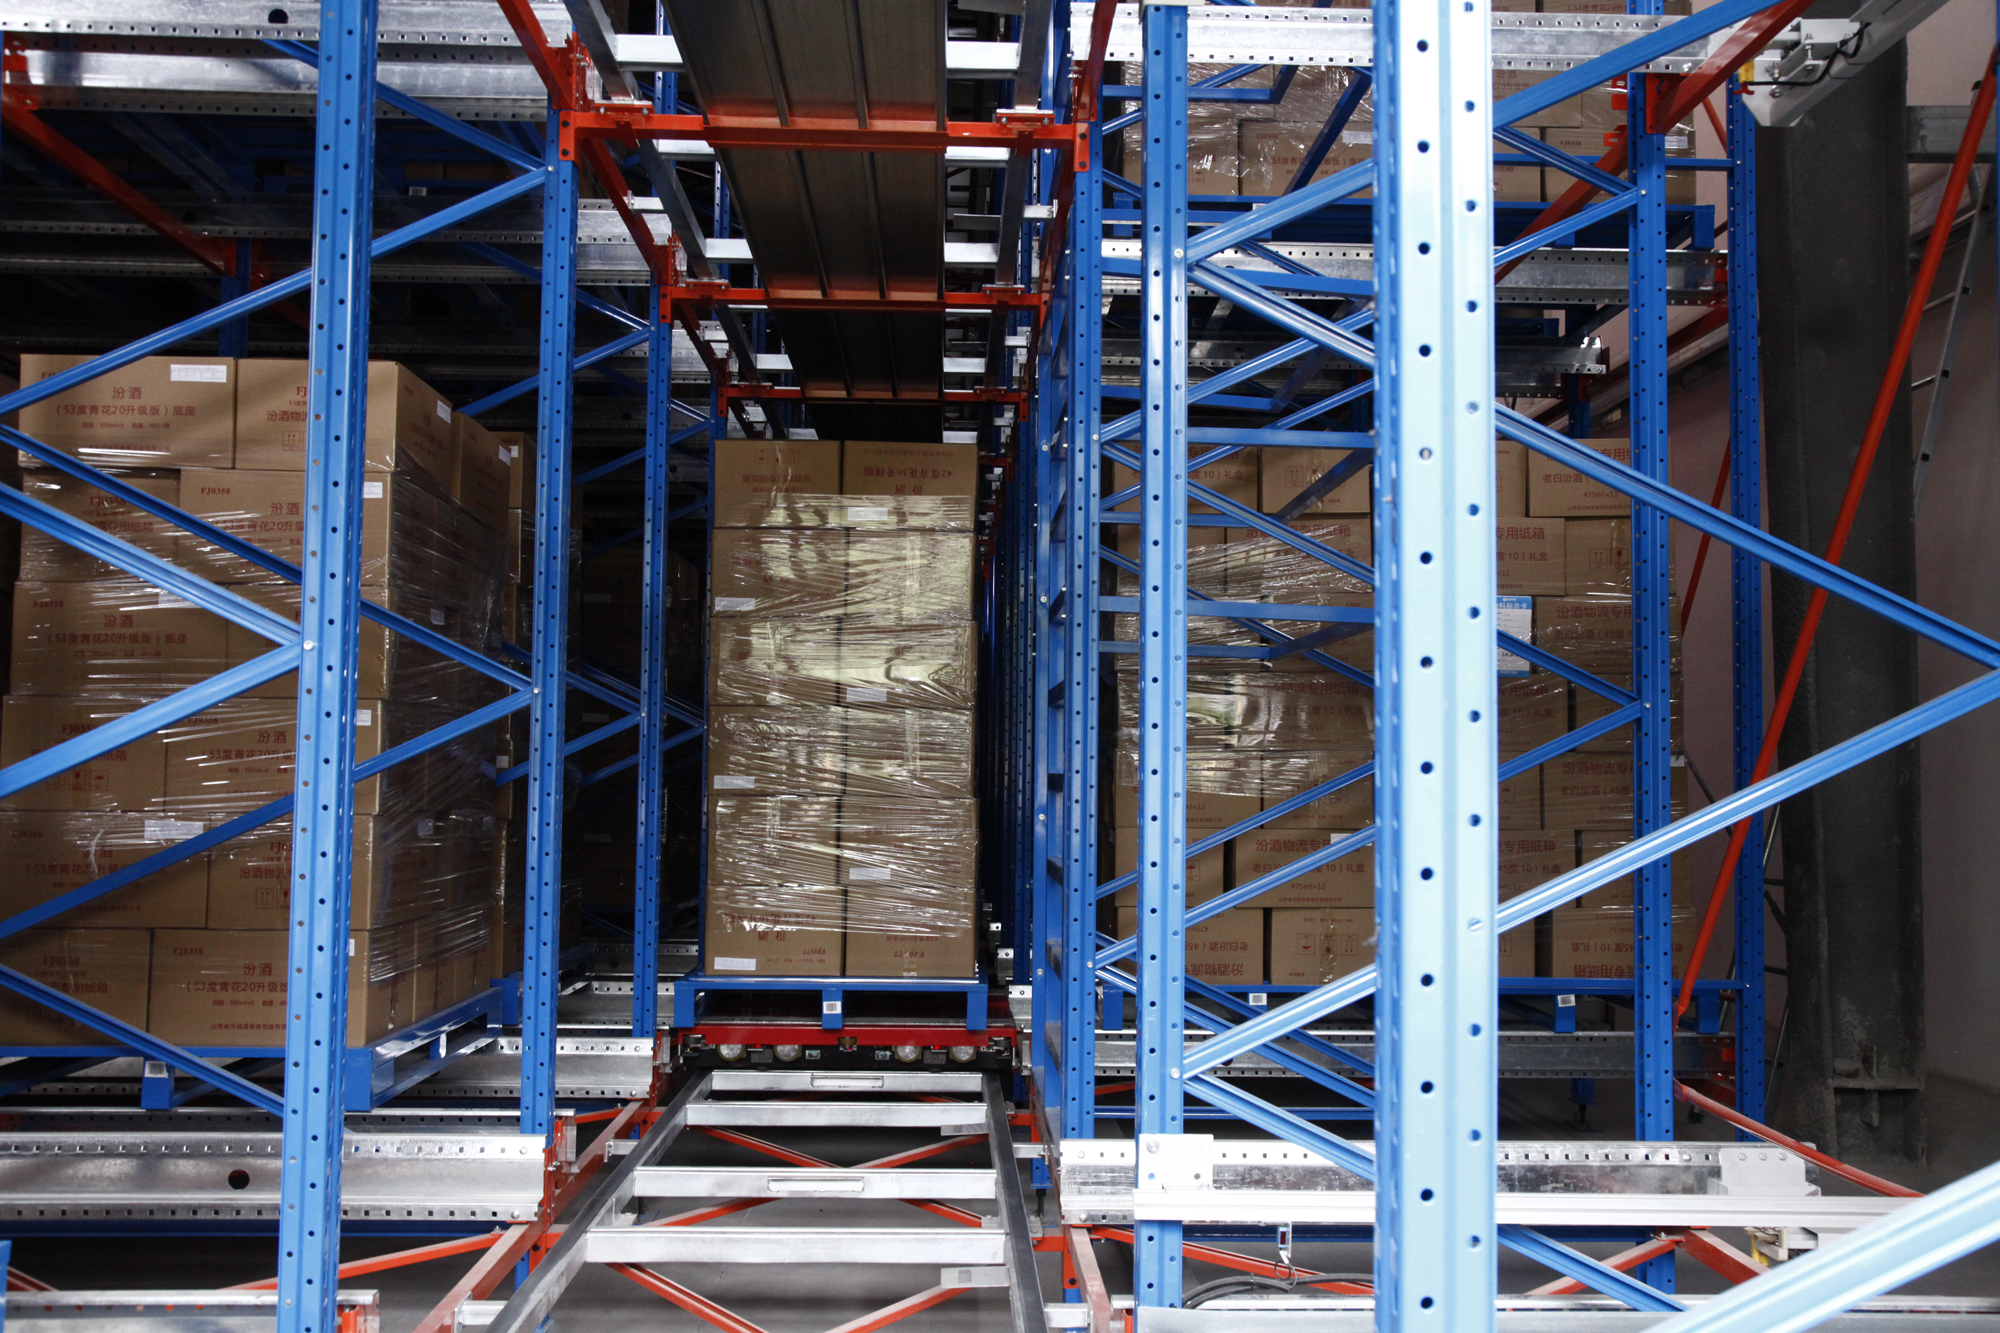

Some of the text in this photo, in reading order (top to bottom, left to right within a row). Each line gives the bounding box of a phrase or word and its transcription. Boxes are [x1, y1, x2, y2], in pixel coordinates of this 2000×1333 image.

[112, 387, 142, 400] 汾酒
[201, 487, 231, 495] FJ0358
[271, 502, 300, 515] 汾酒
[104, 615, 133, 628] 汾酒
[258, 730, 287, 744] 汾酒
[173, 947, 203, 956] FJ0358
[242, 962, 272, 977] 汾酒
